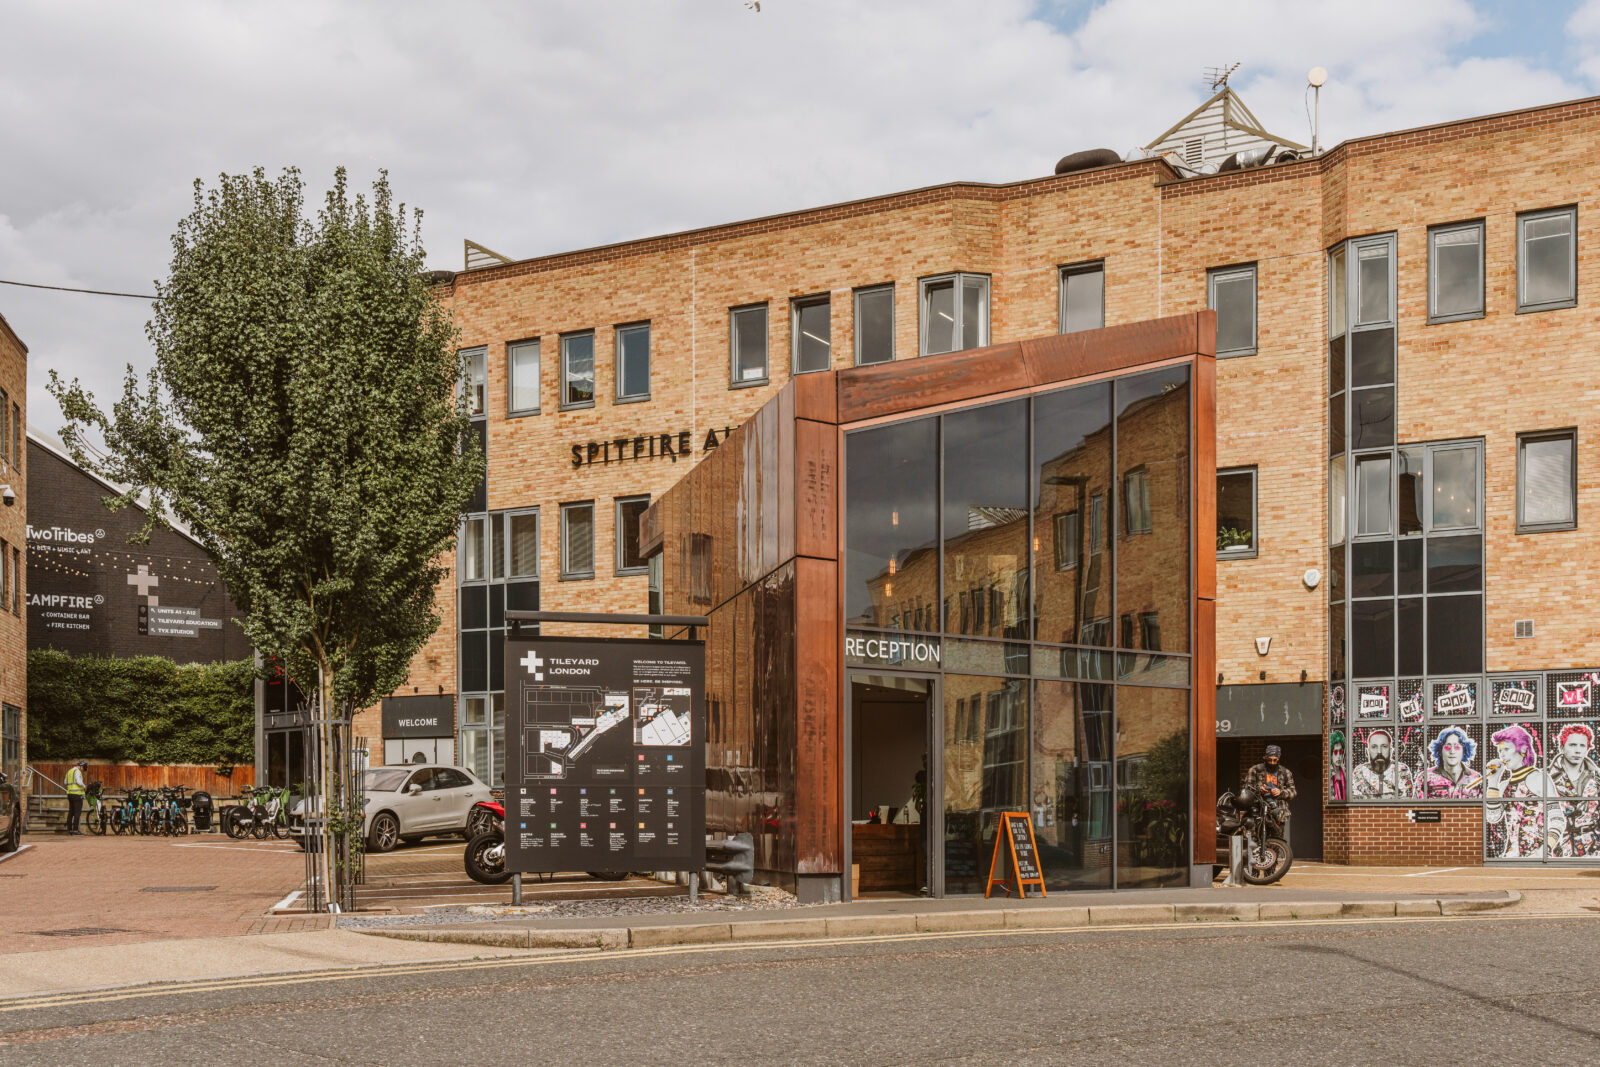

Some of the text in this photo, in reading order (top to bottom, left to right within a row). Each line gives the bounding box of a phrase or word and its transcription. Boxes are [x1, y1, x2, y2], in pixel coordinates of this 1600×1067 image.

[572, 432, 691, 466] SPITFIRE
[26, 525, 94, 543] TwoTribes
[46, 611, 77, 619] CONTAINER
[845, 638, 940, 662] RECEPTION
[549, 658, 599, 666] TILEYARD
[1440, 692, 1468, 708] MAY
[1564, 689, 1583, 703] WE
[398, 718, 438, 727] WELCOME
